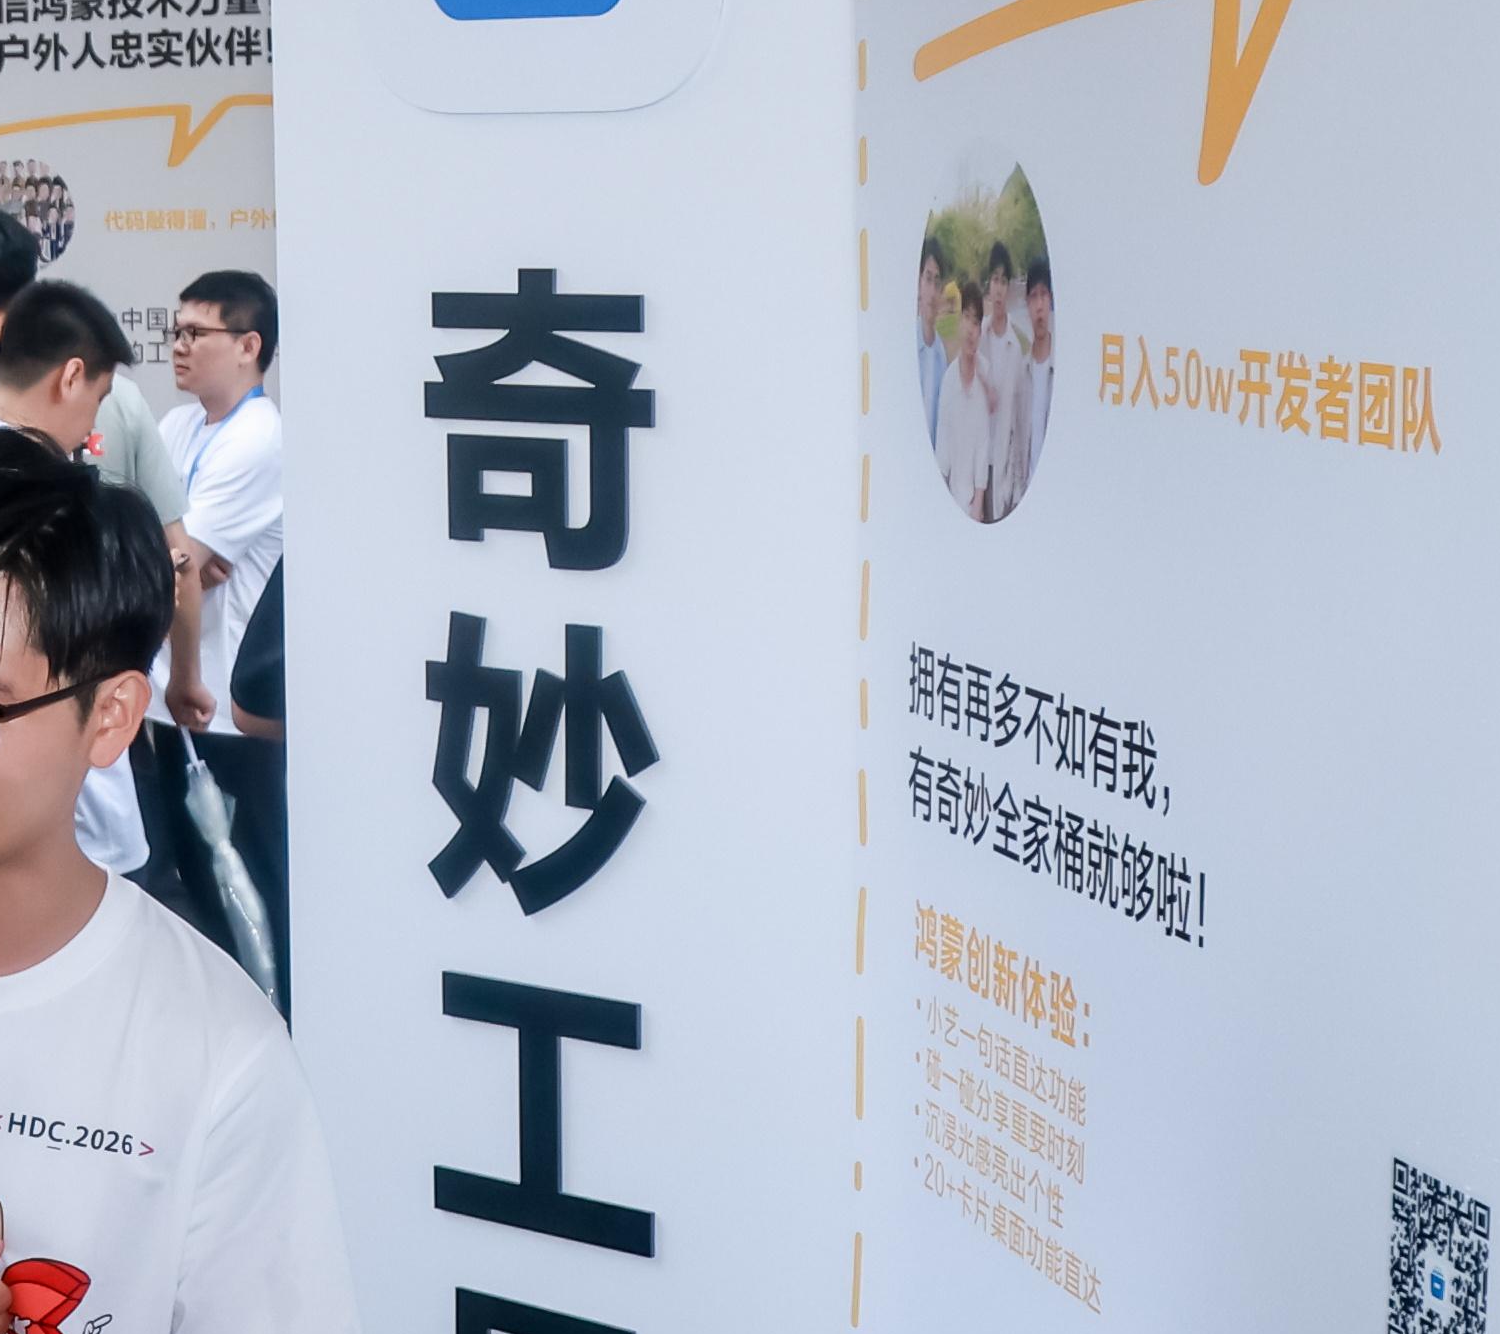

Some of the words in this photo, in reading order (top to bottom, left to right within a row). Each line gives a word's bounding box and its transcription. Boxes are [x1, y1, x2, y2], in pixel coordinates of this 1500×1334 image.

[104, 208, 277, 232] 代码敲得溜，户外
[114, 307, 180, 332] 中国
[1099, 332, 1443, 456] 月入50w开发者团队
[908, 641, 1170, 817] 拥有再多不如有我，
[908, 745, 1206, 948] 有奇妙全家桶就够啦！
[915, 899, 1091, 1048] 鸿蒙创新体验：
[926, 995, 1087, 1127] 小艺一句话直达功能
